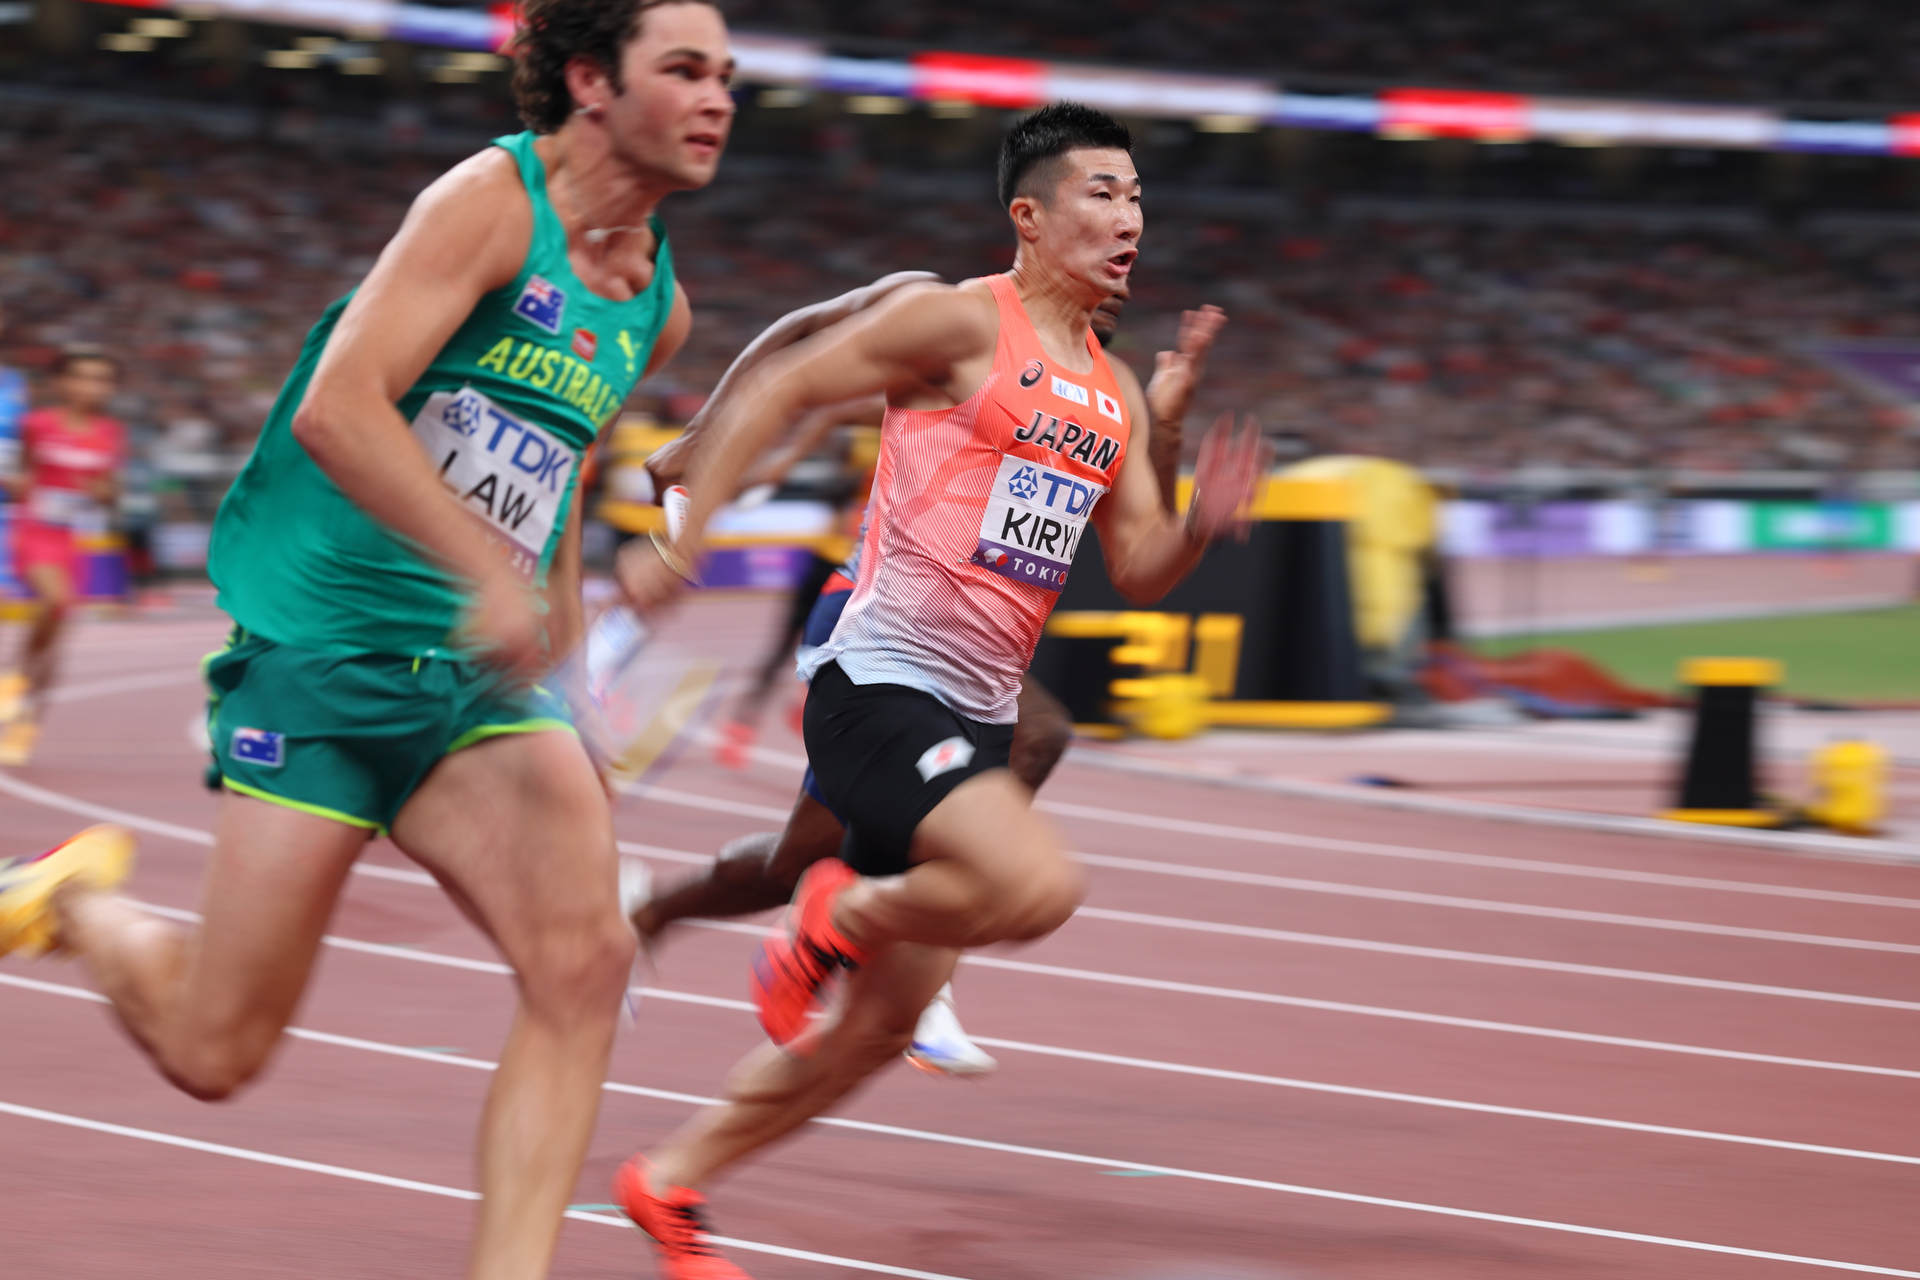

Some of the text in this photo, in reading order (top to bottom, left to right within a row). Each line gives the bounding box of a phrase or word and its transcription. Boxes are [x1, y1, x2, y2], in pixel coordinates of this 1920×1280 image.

[476, 336, 621, 428] AUSTRALI
[1053, 379, 1086, 402] ACN
[486, 406, 570, 491] TDK
[1013, 409, 1121, 472] JAPAN
[438, 449, 538, 531] LAW
[1041, 471, 1104, 518] TDK
[1000, 506, 1082, 561] KIRYU
